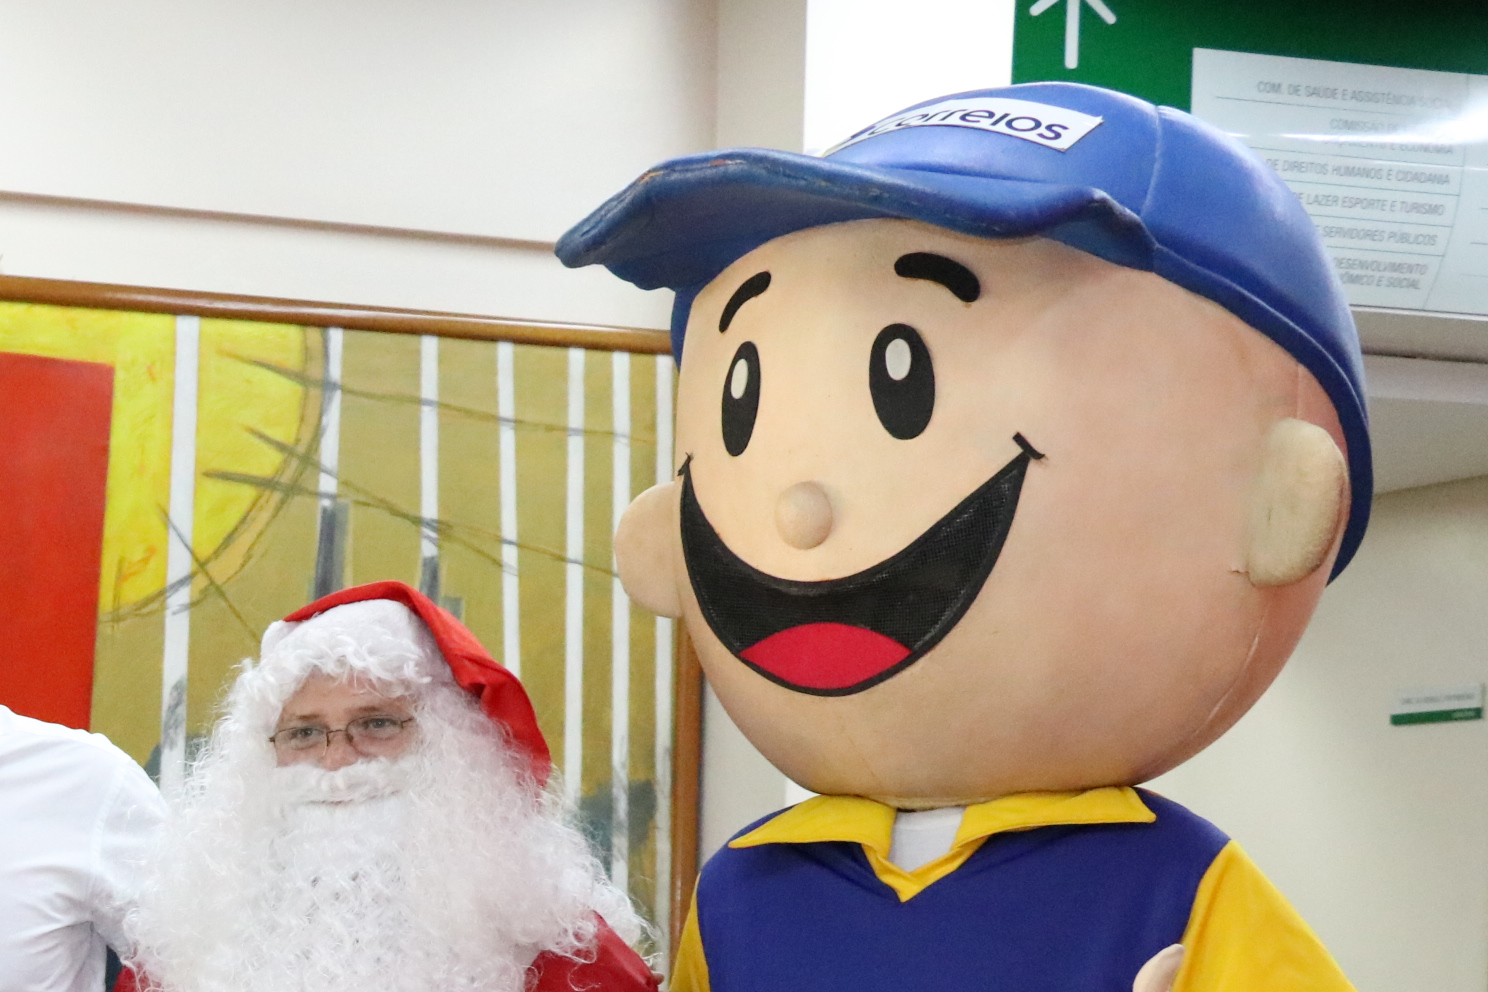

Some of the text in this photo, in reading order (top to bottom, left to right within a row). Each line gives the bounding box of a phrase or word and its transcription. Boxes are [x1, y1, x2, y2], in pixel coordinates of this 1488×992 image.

[1287, 84, 1302, 97] DE
[1342, 89, 1348, 100] E
[867, 107, 1069, 141] Correios
[1282, 160, 1329, 175] DIREITOS
[1332, 164, 1384, 181] HUMANOS
[1386, 168, 1393, 181] E
[1396, 170, 1450, 185] CIDADANIA
[1306, 193, 1339, 207] LAZER
[1342, 196, 1387, 212] ESPORTE
[1390, 200, 1397, 212] E
[1399, 201, 1445, 216] TURISMO
[1322, 225, 1385, 242] SERVIDORES
[1376, 275, 1384, 287] E
[1386, 276, 1421, 289] SOCIAL
